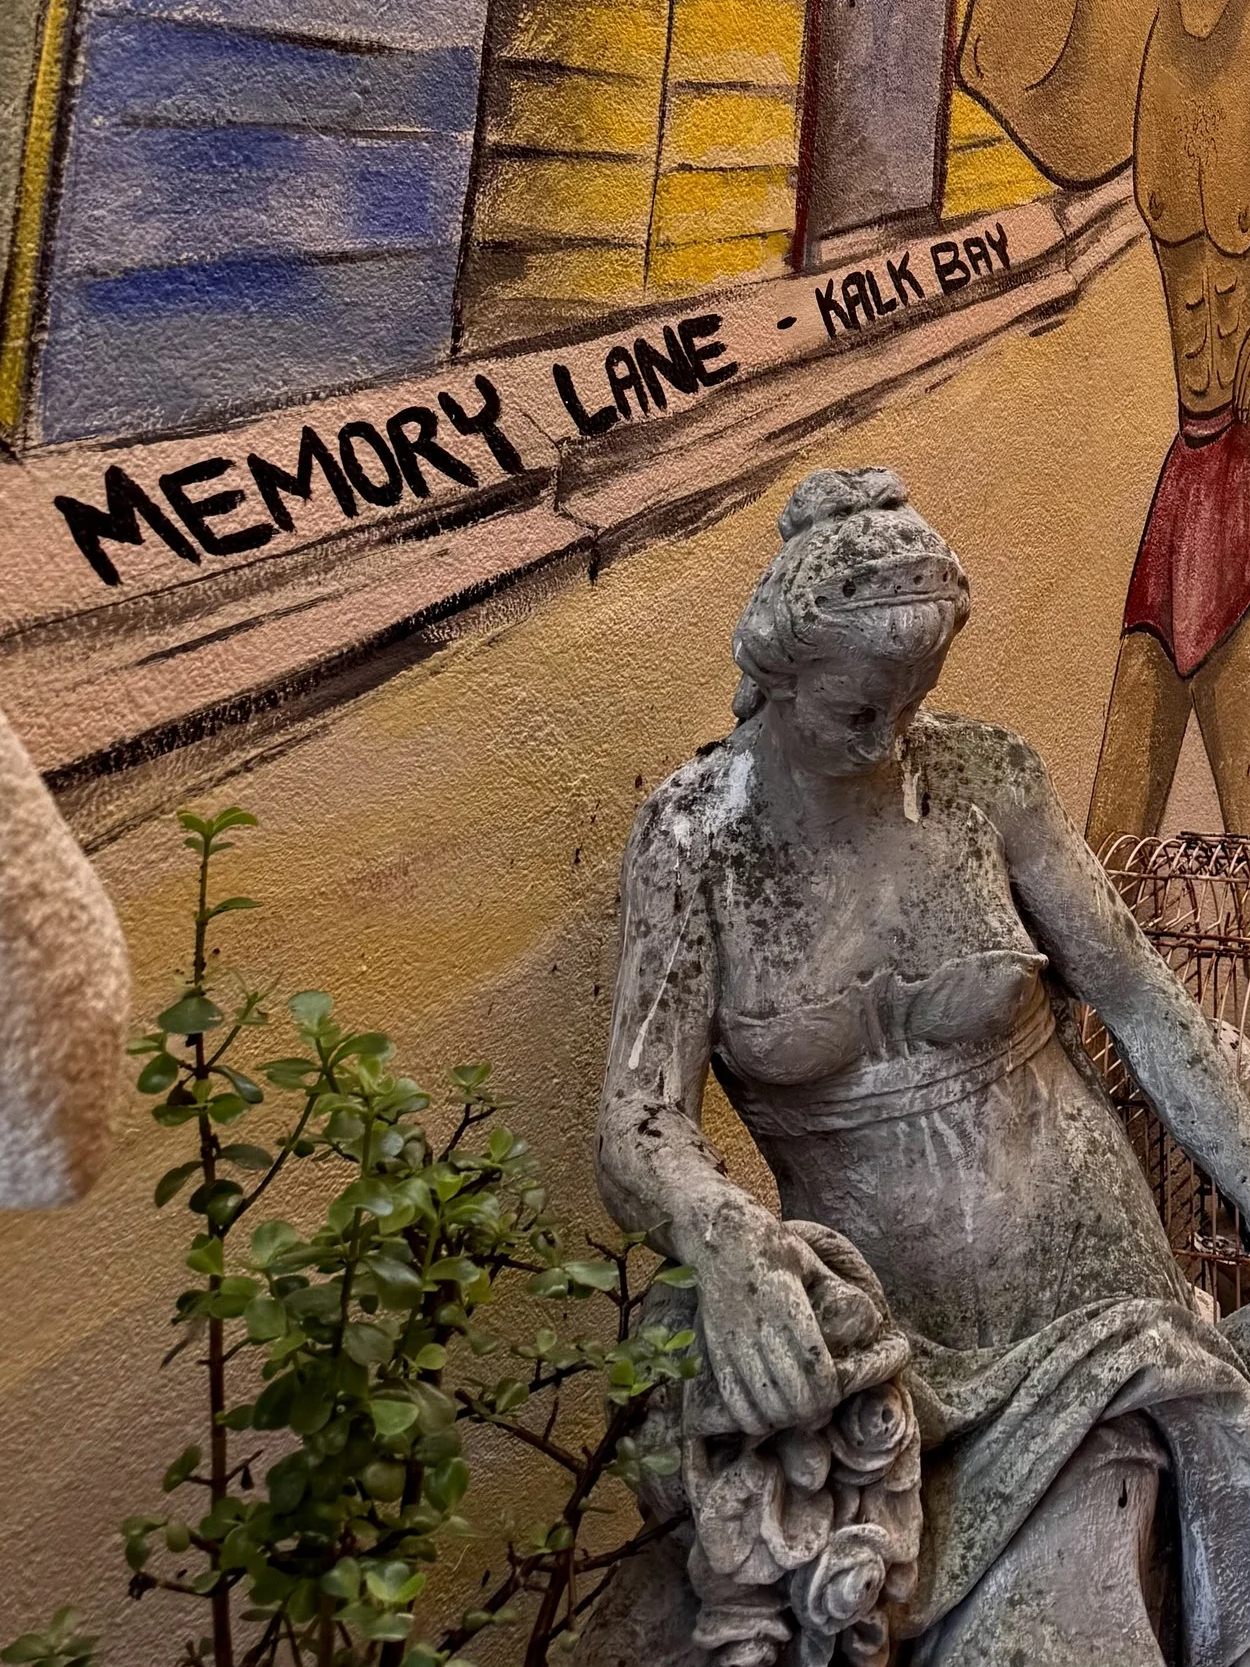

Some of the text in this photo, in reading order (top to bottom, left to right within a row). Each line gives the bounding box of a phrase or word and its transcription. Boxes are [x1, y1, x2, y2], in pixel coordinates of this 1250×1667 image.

[54, 373, 526, 586] MEMORY
[552, 314, 739, 438] LANE
[814, 250, 924, 338] KALK
[933, 225, 1010, 297] BAY
